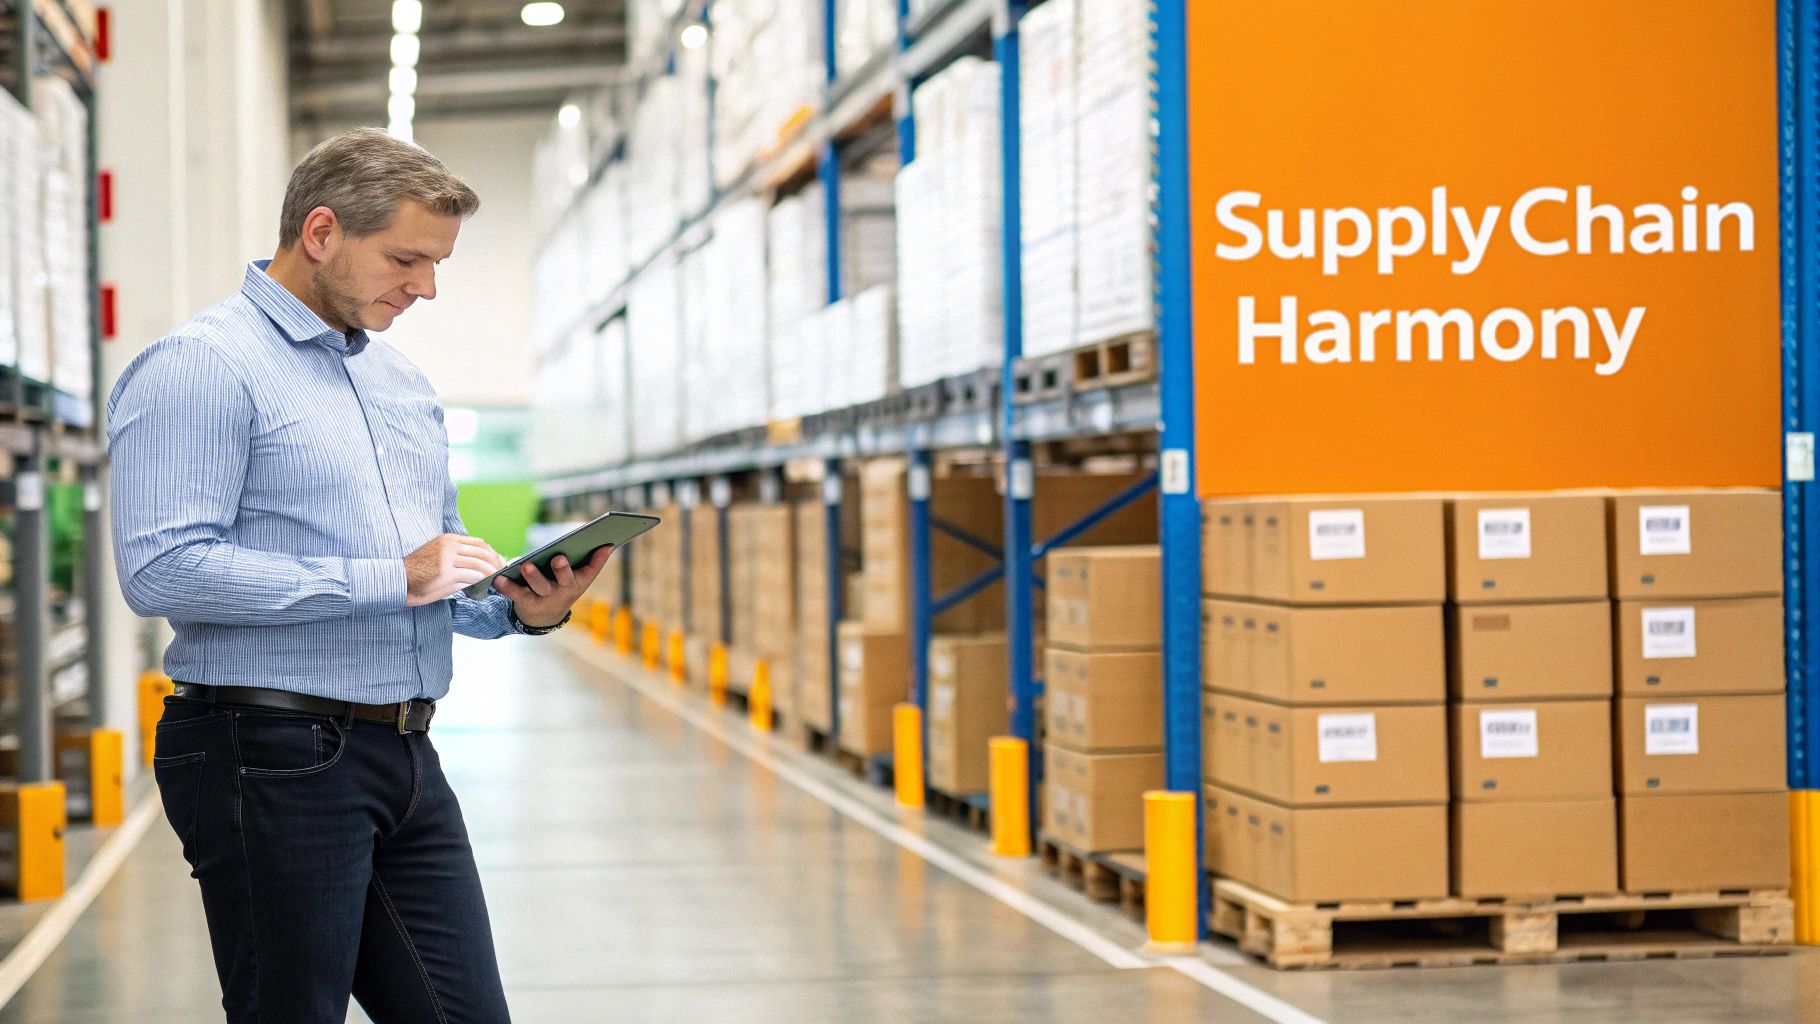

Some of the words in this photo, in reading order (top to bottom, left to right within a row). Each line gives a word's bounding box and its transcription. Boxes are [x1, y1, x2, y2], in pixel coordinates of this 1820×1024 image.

[1215, 185, 1502, 275] Supply
[1509, 184, 1755, 256] Chain
[1238, 295, 1647, 376] Harmony
